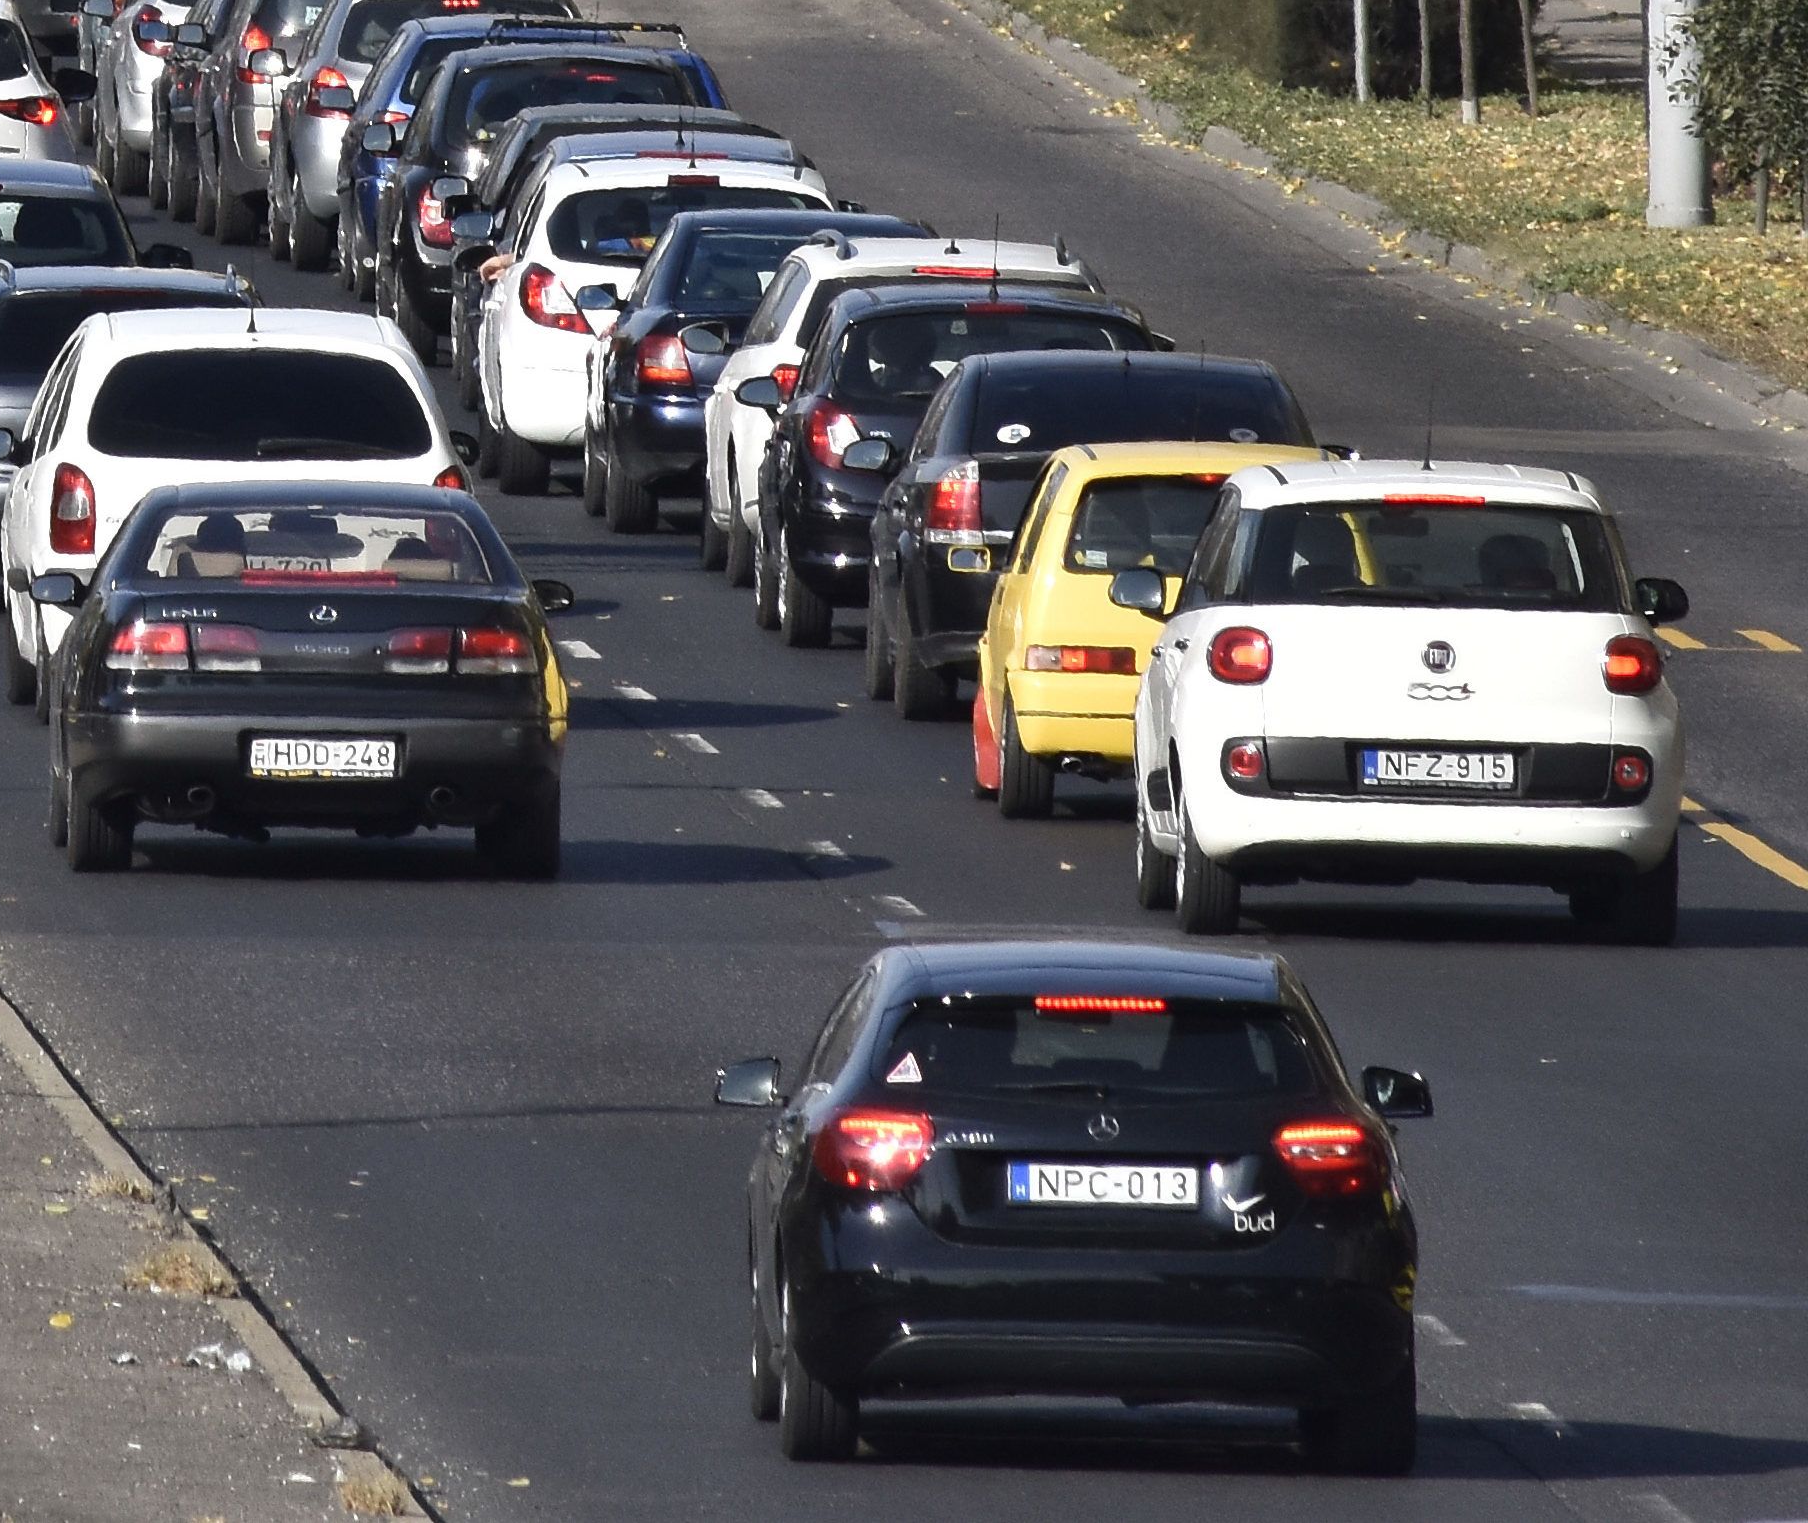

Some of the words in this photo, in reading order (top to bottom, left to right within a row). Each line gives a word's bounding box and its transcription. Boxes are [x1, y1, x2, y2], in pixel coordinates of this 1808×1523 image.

[275, 742, 390, 767] HDD-248
[1385, 753, 1506, 780] NFZ-915
[1038, 1168, 1188, 1201] NPC-013
[1234, 1210, 1275, 1232] bud
